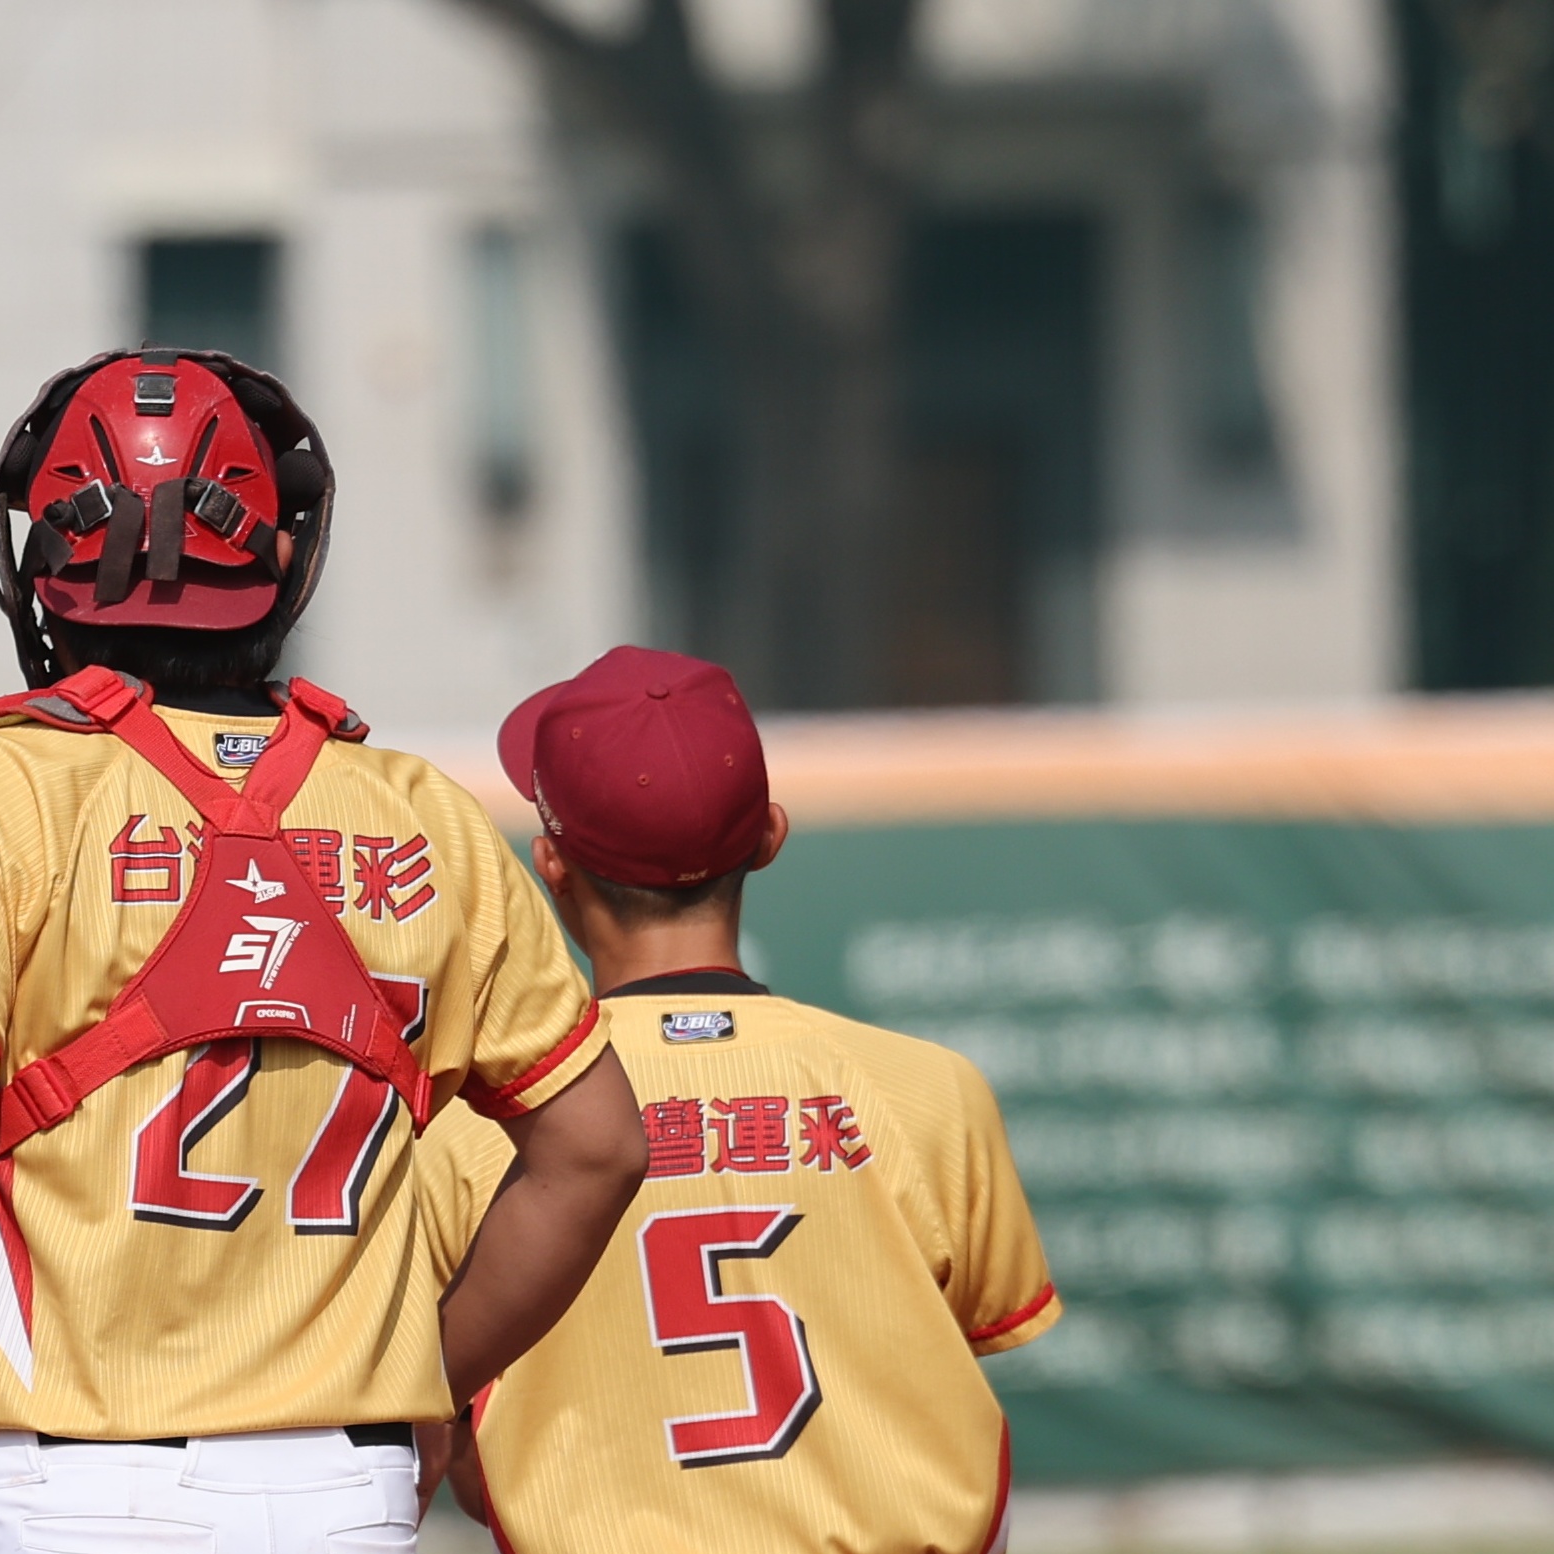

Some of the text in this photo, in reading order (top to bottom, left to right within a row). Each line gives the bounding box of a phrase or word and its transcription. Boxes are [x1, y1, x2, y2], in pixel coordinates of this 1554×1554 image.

[127, 972, 430, 1237] 27
[641, 1094, 873, 1181] 灣運彩
[635, 1203, 823, 1470] 5
